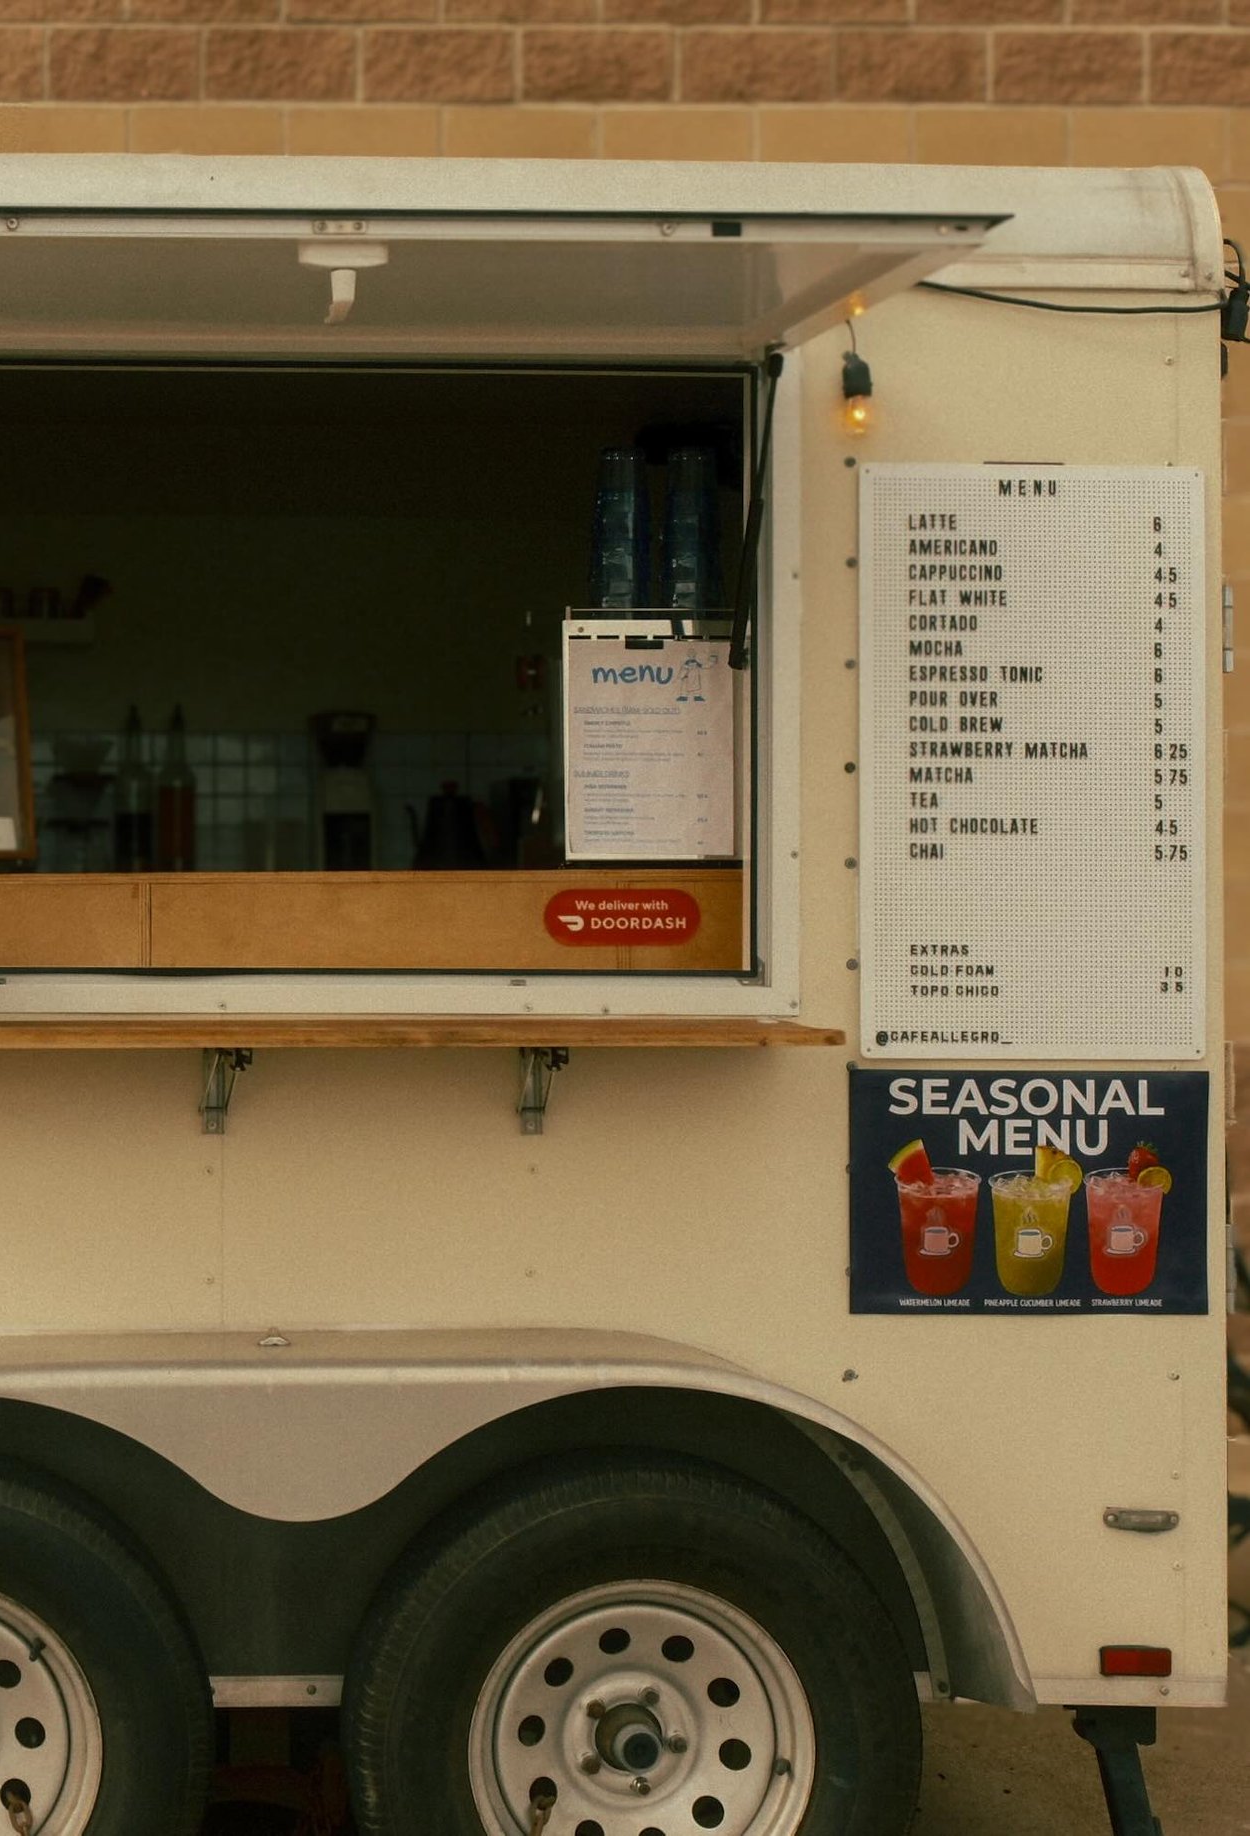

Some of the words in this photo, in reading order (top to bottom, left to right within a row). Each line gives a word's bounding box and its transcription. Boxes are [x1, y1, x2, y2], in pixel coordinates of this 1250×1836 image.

[999, 480, 1057, 496] MENU
[908, 514, 957, 531] LATTE
[1153, 516, 1162, 532] 6
[908, 540, 998, 557] AMERICANO
[1154, 542, 1163, 558] 4
[909, 565, 1003, 582] CAPPUCCINO
[909, 590, 947, 607] FLAT
[959, 590, 1008, 607] WHITE
[909, 615, 978, 632] CORTADO
[1154, 617, 1163, 633] 4
[909, 640, 963, 657] MOCHA
[1154, 642, 1162, 658] 6
[591, 663, 674, 685] menu
[909, 666, 988, 683] ESPRESSO
[1000, 666, 1043, 683] TONIC
[1154, 668, 1162, 684] 6
[909, 691, 948, 708] POUR
[959, 691, 998, 708] OVER
[1154, 693, 1163, 709] 5
[909, 716, 949, 733] COLD
[960, 716, 1003, 733] BREW
[1154, 718, 1163, 734] 5
[909, 742, 1013, 759] STRAWBERRY
[1025, 742, 1088, 759] MATCHA
[909, 767, 973, 784] MATCHA
[910, 792, 939, 809] TEA
[1154, 794, 1163, 810] 5
[910, 818, 939, 835] HOT
[950, 818, 1039, 835] CHOCOLATE
[910, 843, 944, 860] CHAI
[575, 900, 595, 911] We
[598, 900, 640, 911] deliver
[642, 900, 668, 911] with
[590, 917, 686, 930] DOORDASH
[910, 945, 969, 957] EXTRAS
[910, 965, 949, 976] COLD
[955, 965, 994, 976] FOAM
[910, 985, 949, 997] TOPO
[955, 985, 999, 997] CHICO
[888, 1077, 1165, 1116] SEASONAL
[958, 1118, 1109, 1156] MENU
[899, 1298, 942, 1307] WATERMELON
[944, 1298, 970, 1307] LIMEADE
[984, 1298, 1018, 1308] PINEAPPLE
[1020, 1298, 1053, 1308] CUCUMBER
[1055, 1298, 1081, 1308] LIMEADE
[1091, 1298, 1133, 1308] STRAWBERRY
[1135, 1298, 1162, 1308] LIMEADE
